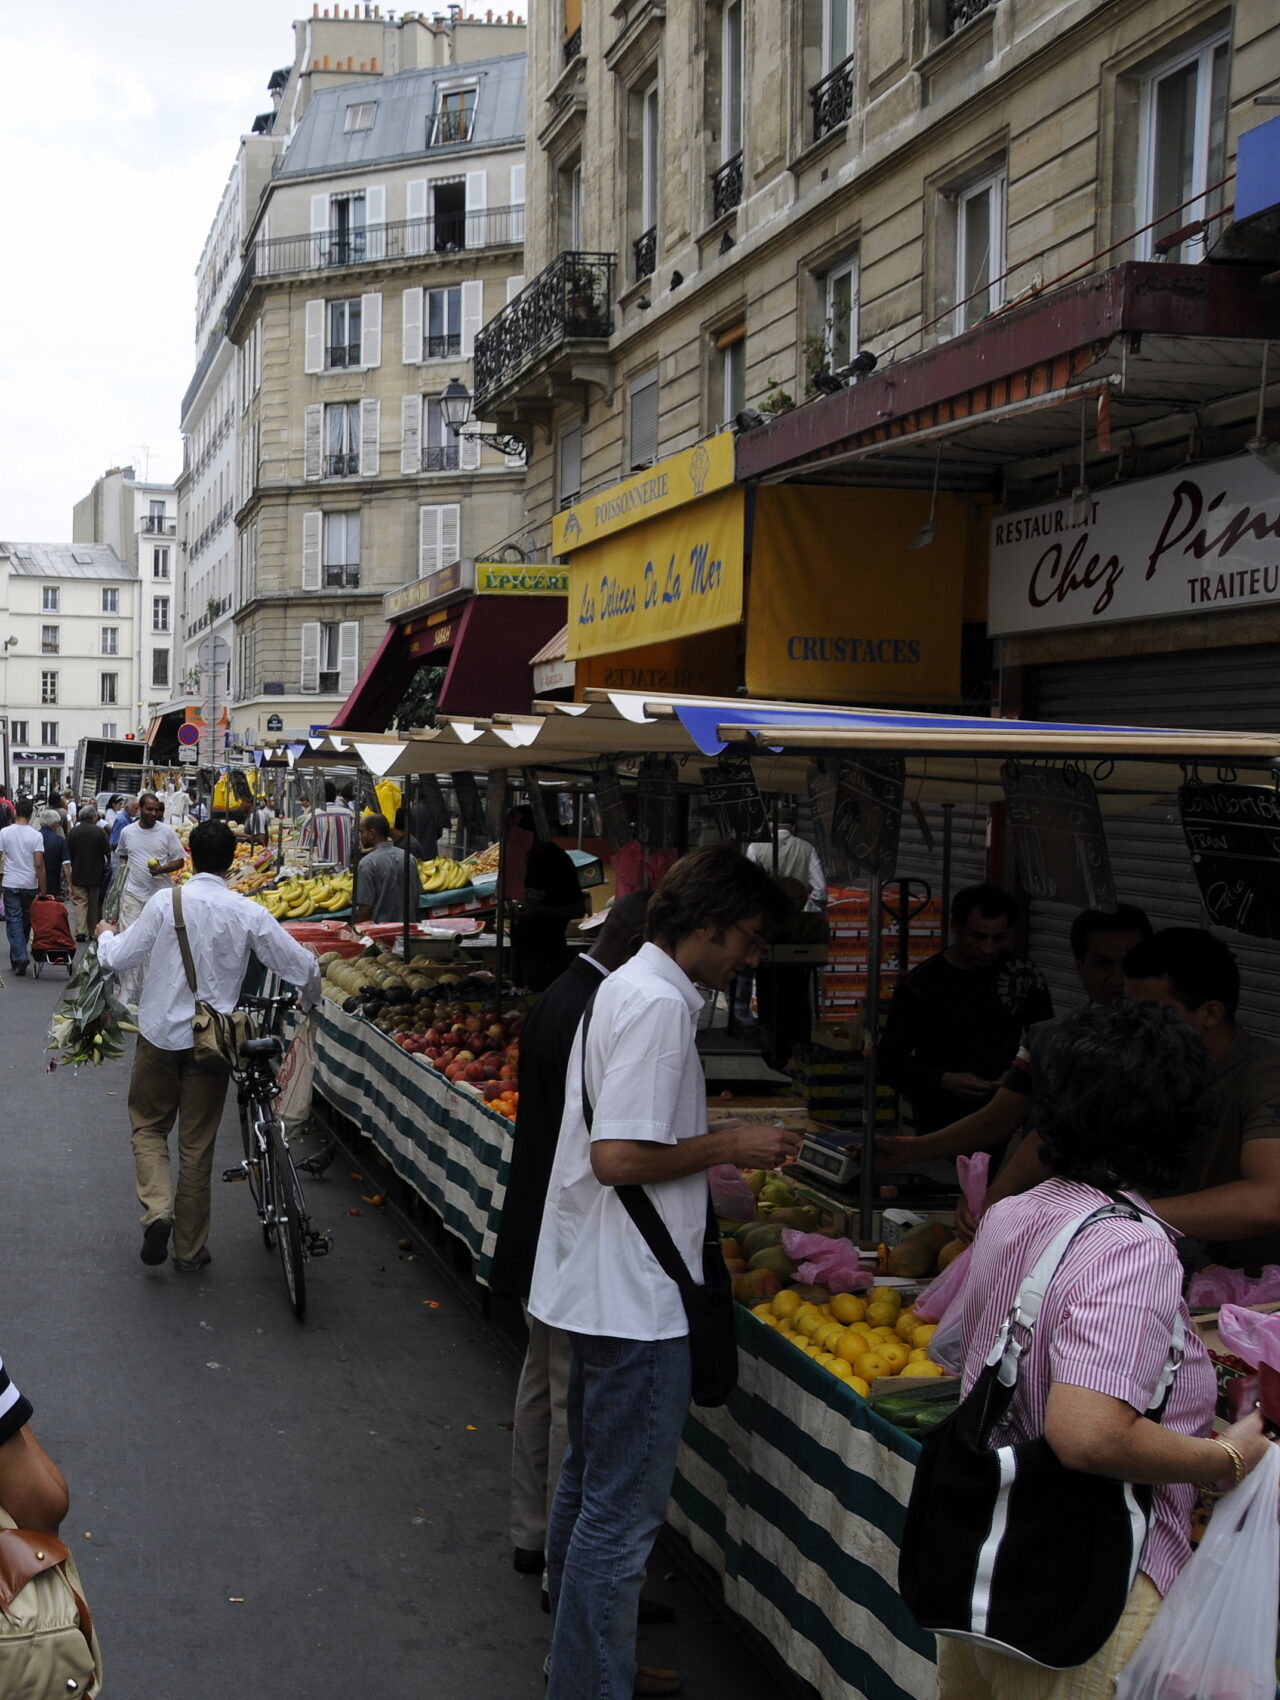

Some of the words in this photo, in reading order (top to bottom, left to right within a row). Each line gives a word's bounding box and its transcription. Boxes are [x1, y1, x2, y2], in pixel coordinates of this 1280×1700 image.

[595, 473, 669, 528] POISSONNERIE
[995, 502, 1100, 546] RESTAURT
[578, 582, 596, 626] Les
[600, 575, 637, 621] Délices
[644, 560, 659, 611] De
[662, 553, 681, 605] La
[690, 543, 723, 597] Mer
[1028, 533, 1124, 615] Chez
[1187, 565, 1280, 604] TRAITEU
[786, 635, 922, 665] CRUSTACES
